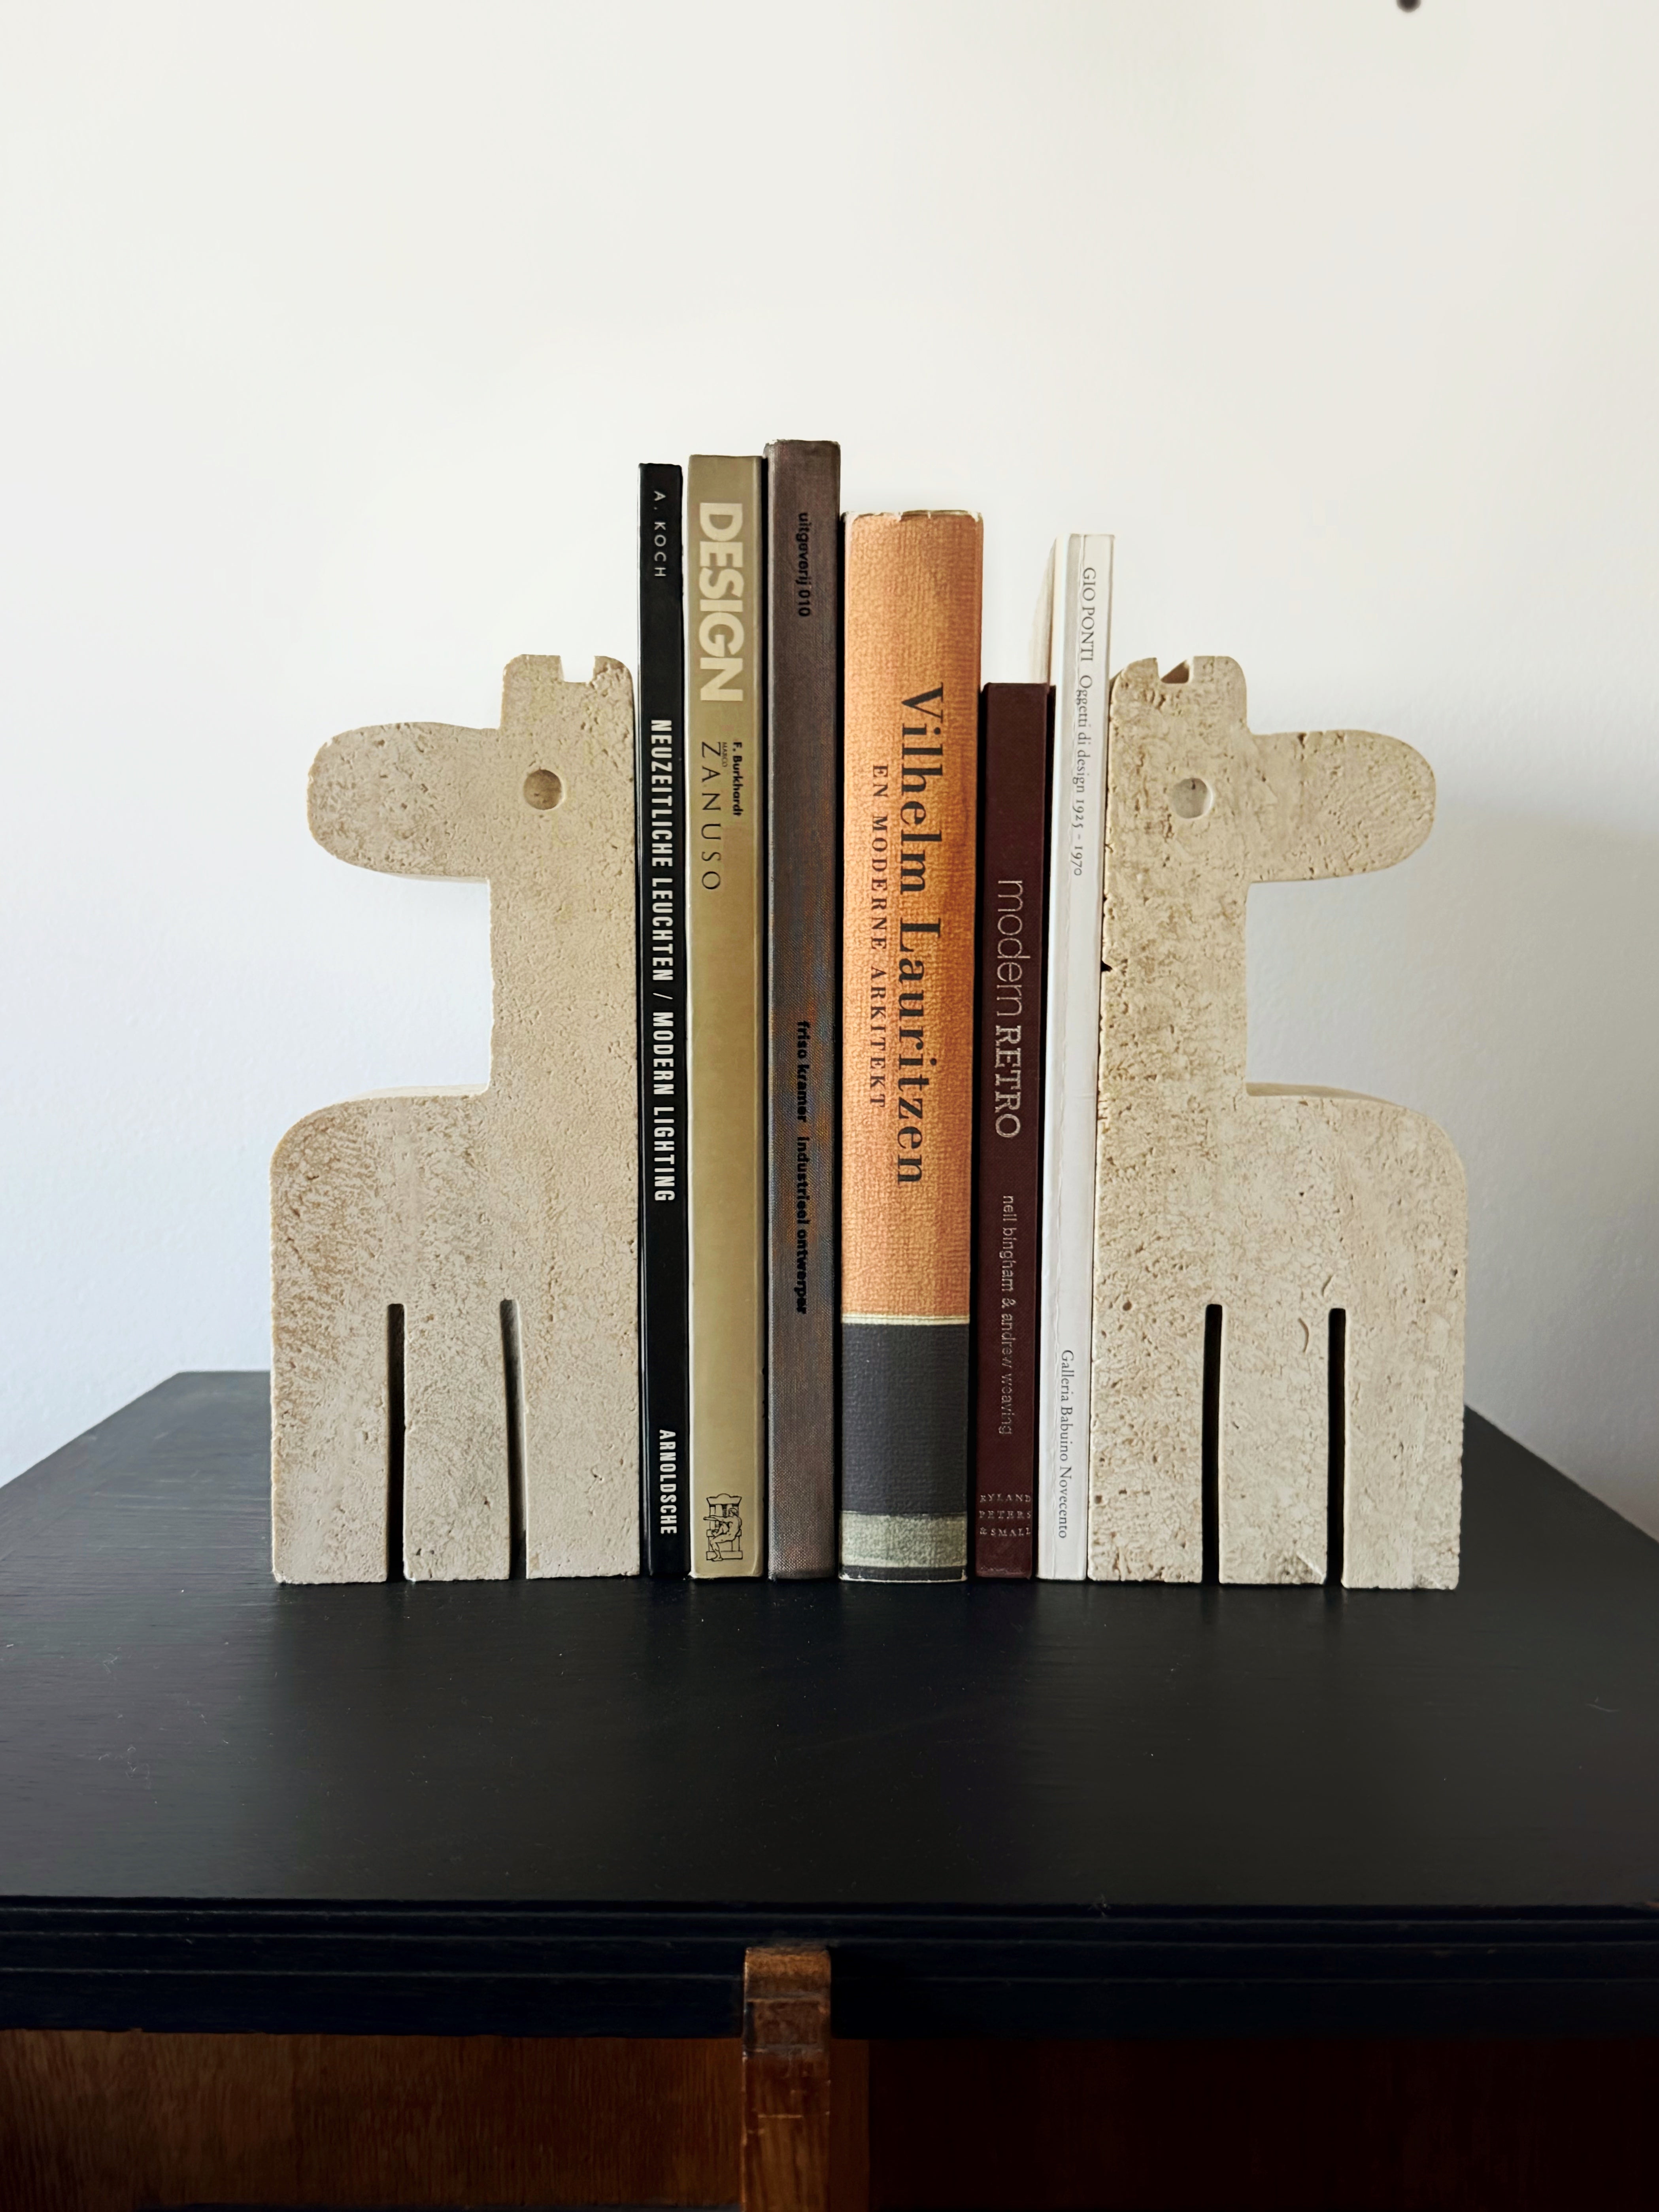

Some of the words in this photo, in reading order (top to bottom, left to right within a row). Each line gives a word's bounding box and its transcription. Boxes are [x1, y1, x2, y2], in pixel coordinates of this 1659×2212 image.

[654, 491, 666, 510] A.
[654, 521, 666, 577] KOCH
[796, 512, 810, 586] uitgeverij
[699, 503, 744, 701] DESIGN
[798, 590, 811, 617] 010
[1083, 567, 1096, 601] GIO
[1081, 607, 1095, 662] PONTI
[1076, 675, 1093, 728] Oggetti
[732, 742, 742, 751] F.
[1078, 732, 1091, 745] di
[651, 719, 672, 867] NEUZEITLICHE
[732, 755, 744, 816] Burkhardt
[872, 764, 888, 798] EN
[901, 682, 943, 895] Vilhelm
[1073, 750, 1090, 793] design
[701, 742, 721, 890] ZANUSO
[1072, 800, 1084, 829] 1925
[871, 815, 888, 950] MODERNE
[1071, 846, 1083, 876] 1970
[652, 878, 673, 980] LEUCHTEN
[997, 880, 1031, 1016] modern
[653, 1012, 674, 1095] MODERN
[797, 1020, 810, 1059] friso
[870, 967, 886, 1107] ARKITEKT
[897, 918, 941, 1185] Lauritzen
[797, 1065, 810, 1123] kramer
[995, 1025, 1021, 1138] RETRO
[654, 1107, 675, 1201] LIGHTING
[797, 1137, 810, 1224] industrieel
[1002, 1196, 1017, 1221] neil
[794, 1229, 809, 1314] ontwerper
[999, 1227, 1017, 1292] bingham
[1002, 1298, 1016, 1308] &
[1001, 1314, 1015, 1368] andrew
[999, 1374, 1015, 1435] weaving
[1060, 1350, 1074, 1402] Galleria
[1060, 1406, 1073, 1461] Babuino
[659, 1429, 677, 1534] ARNOLDSCHE
[1058, 1466, 1072, 1538] Novecento
[979, 1510, 1031, 1519] PETERS
[991, 1527, 1031, 1536] SMALL
